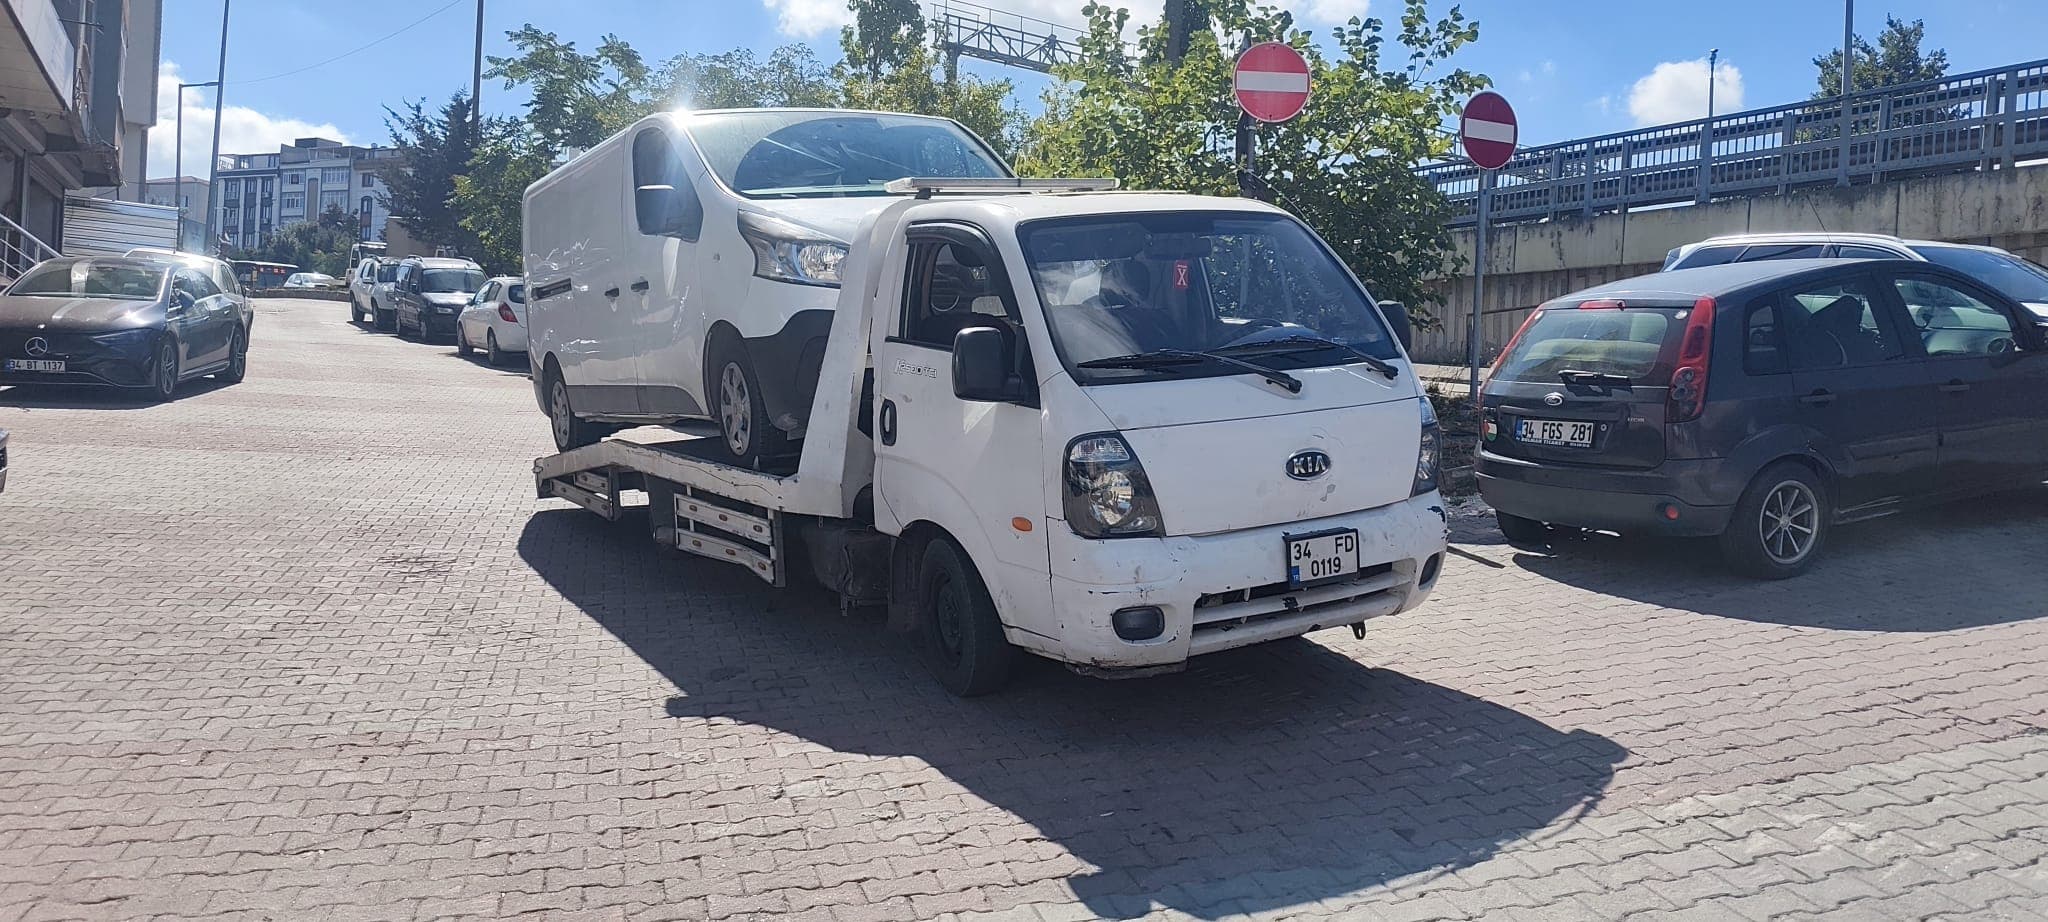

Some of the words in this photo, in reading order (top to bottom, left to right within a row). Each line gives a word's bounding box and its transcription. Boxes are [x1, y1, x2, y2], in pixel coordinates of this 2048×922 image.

[10, 360, 21, 368] 34
[27, 360, 37, 370] BT
[43, 361, 63, 370] 1137
[1523, 421, 1535, 438] 34
[1541, 422, 1563, 440] FGS
[1570, 424, 1592, 442] 281
[1293, 455, 1326, 474] KIA
[1294, 541, 1311, 561] 34
[1334, 535, 1354, 554] FD
[1311, 557, 1341, 577] 0119
